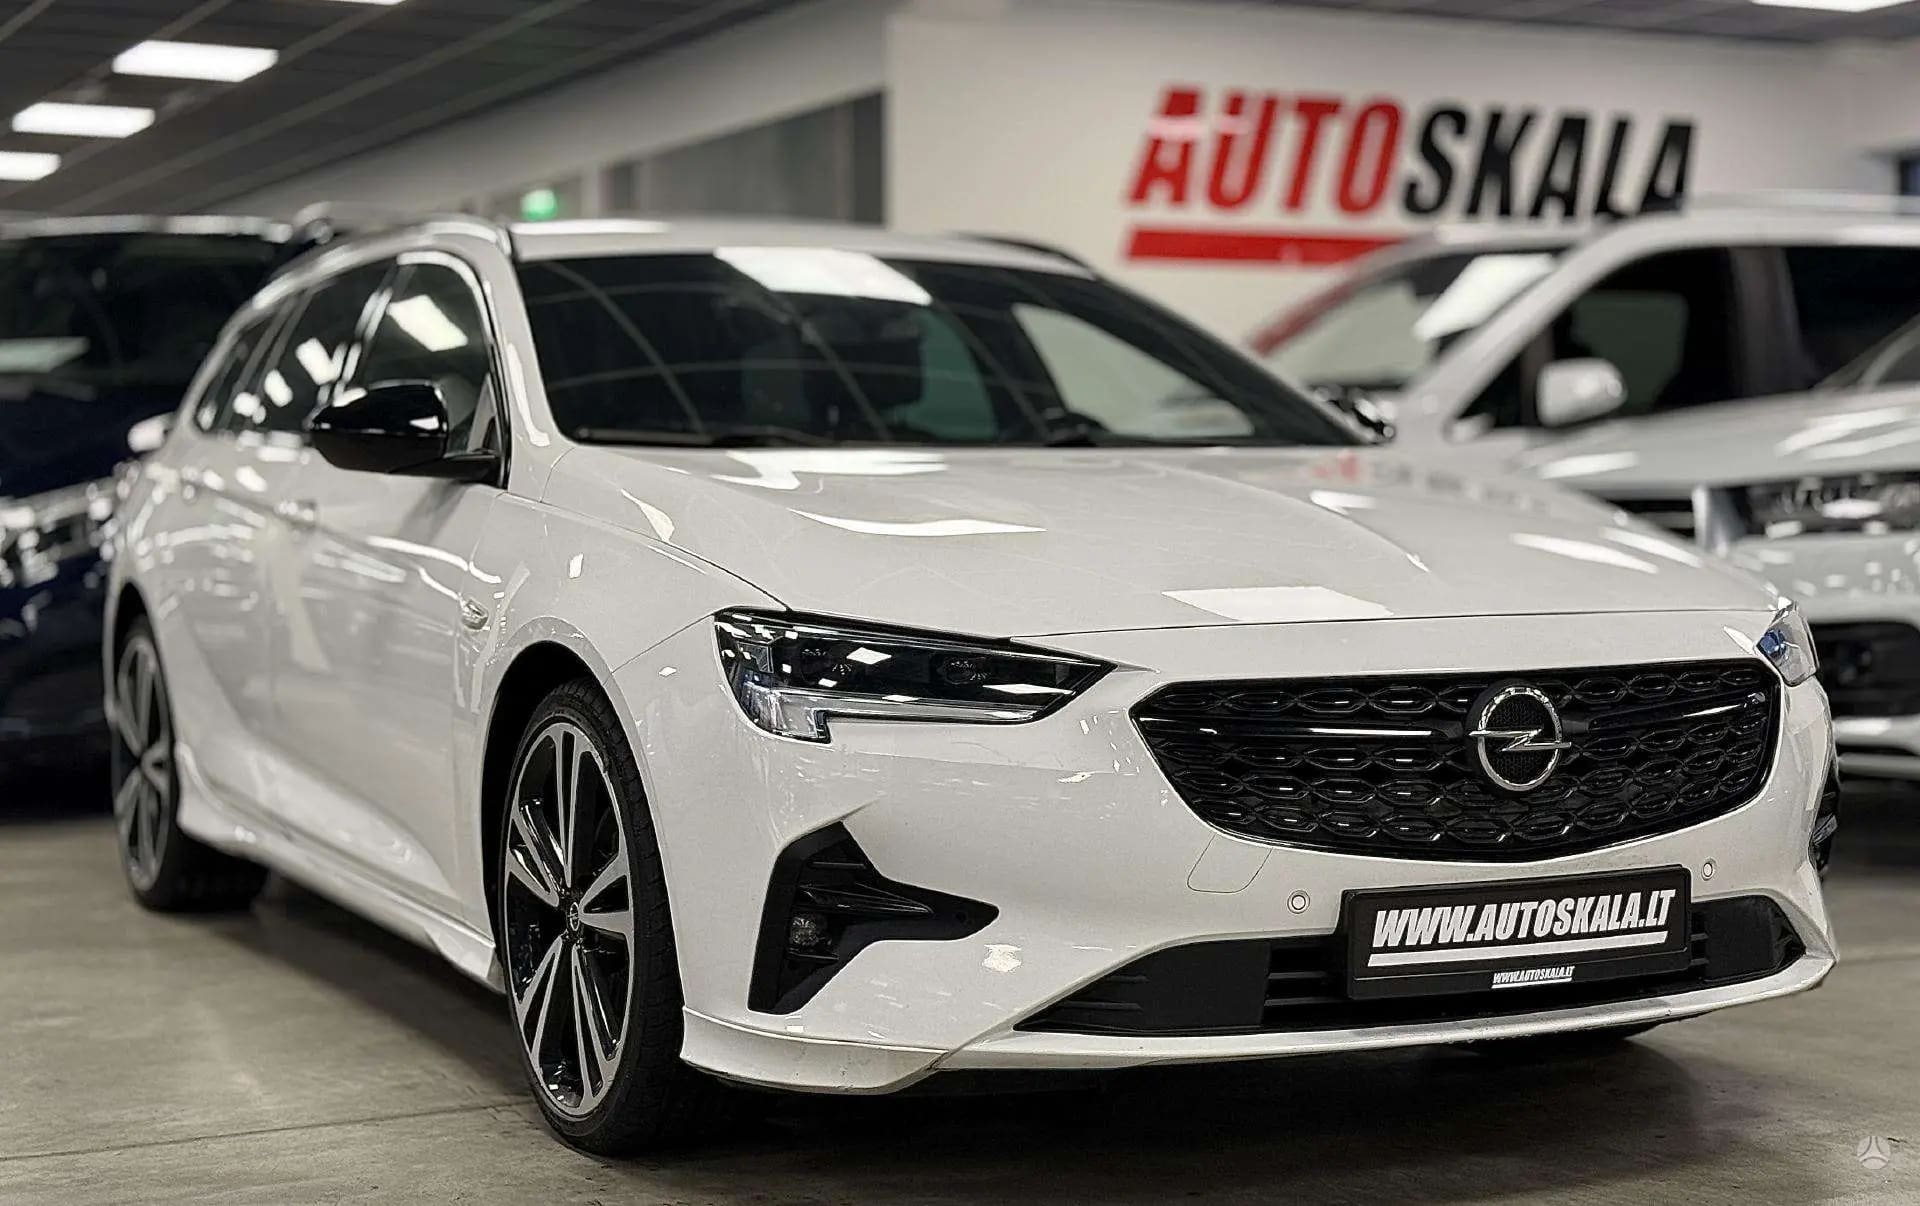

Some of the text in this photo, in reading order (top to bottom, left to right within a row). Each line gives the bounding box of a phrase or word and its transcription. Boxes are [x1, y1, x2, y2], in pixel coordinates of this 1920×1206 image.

[1129, 87, 1695, 219] AUTOSKALA
[1372, 889, 1676, 947] WWW.AUTOSKALA.LT
[1493, 966, 1575, 983] WWW.AUTOSKALA.LT
